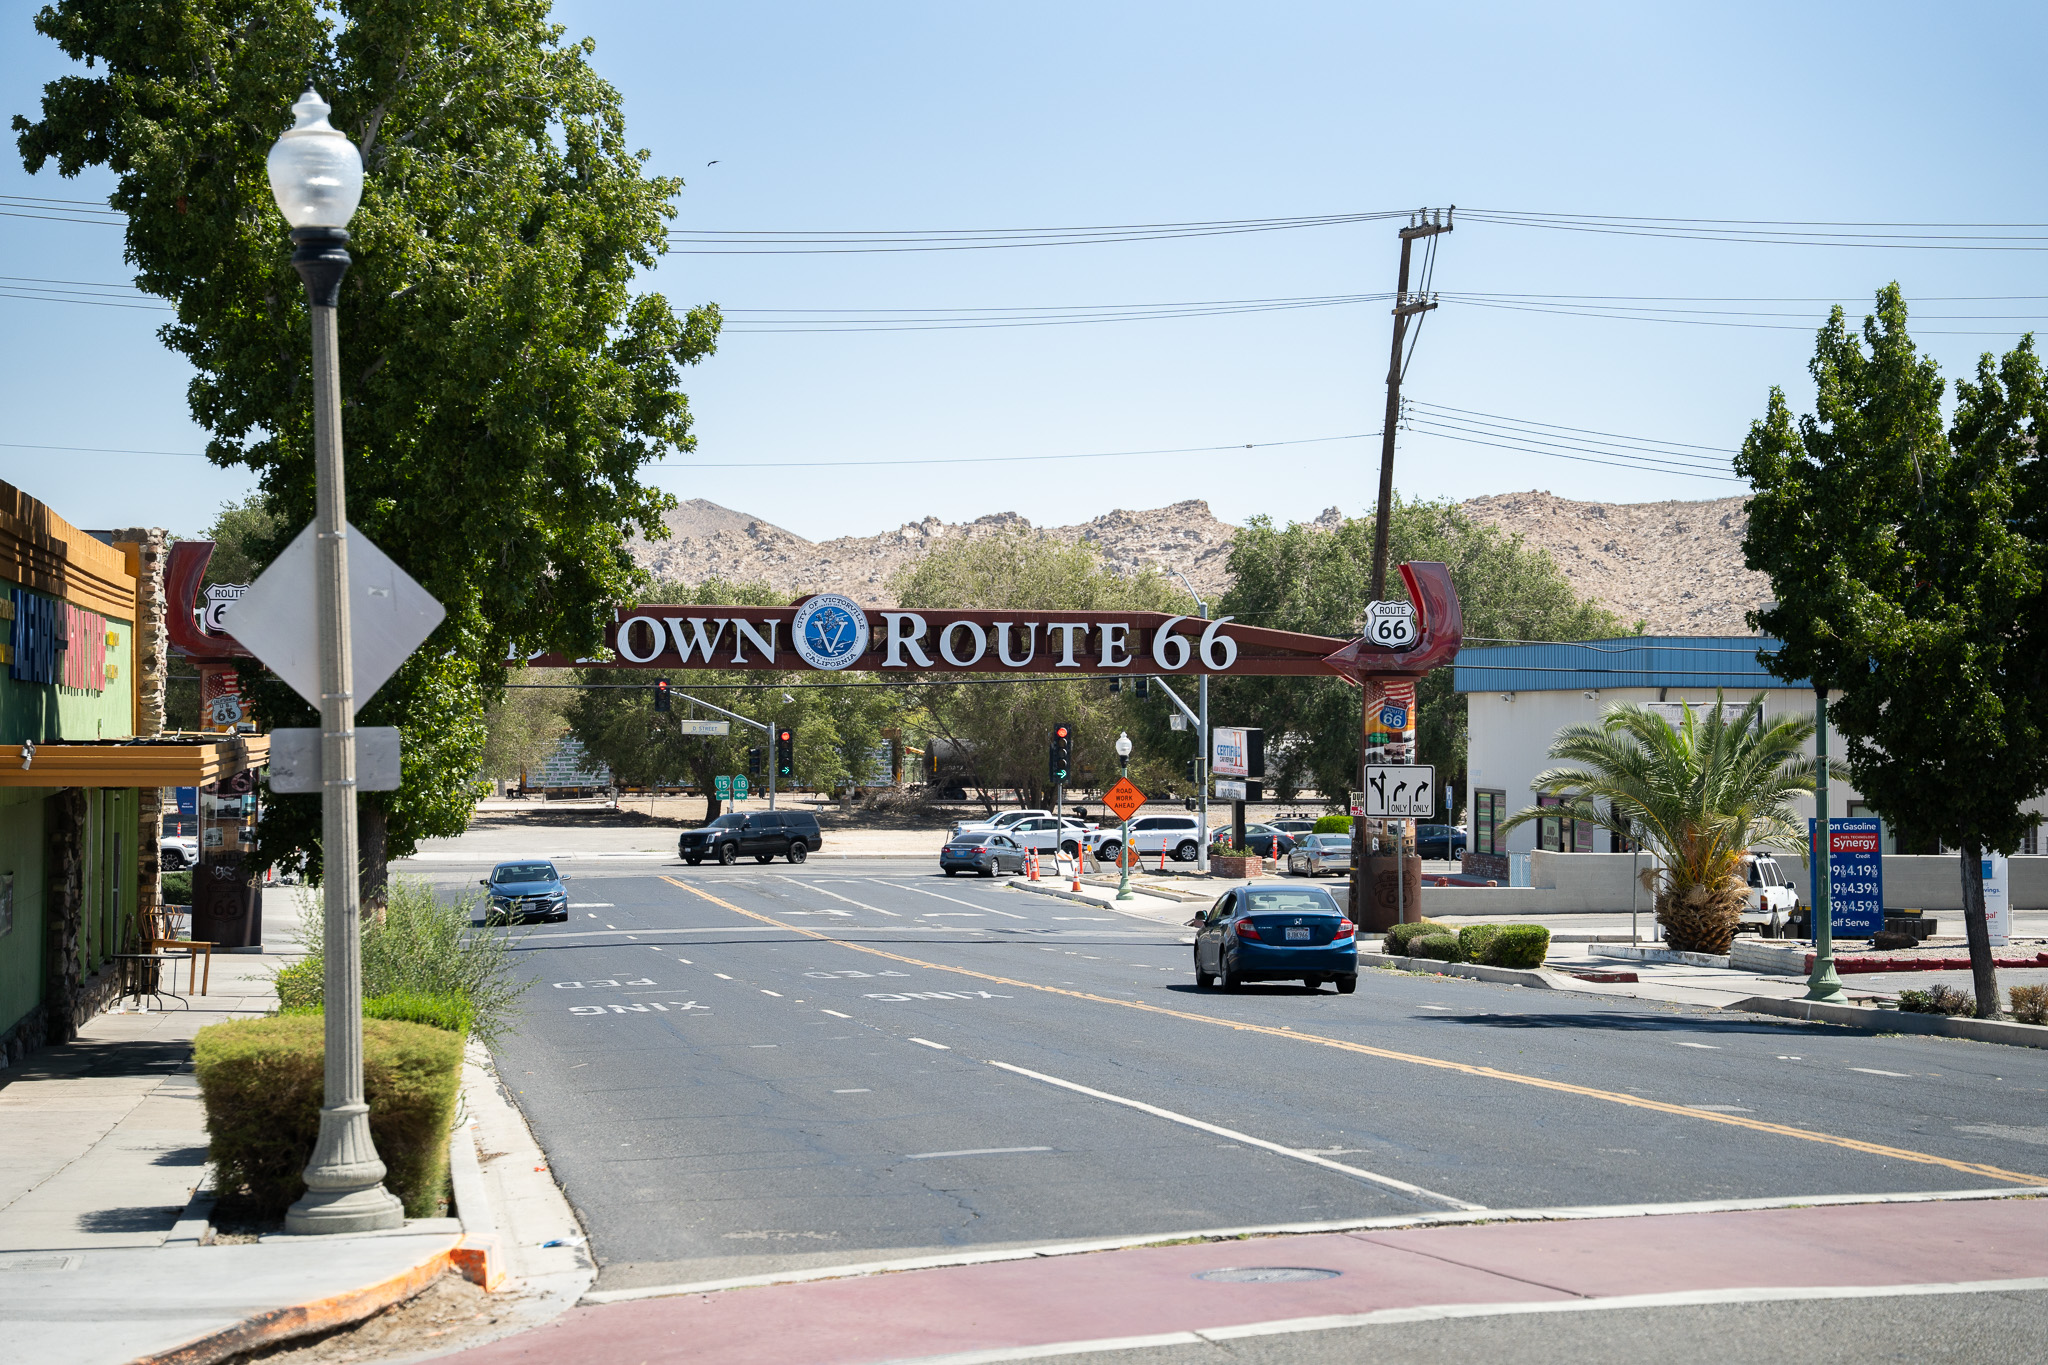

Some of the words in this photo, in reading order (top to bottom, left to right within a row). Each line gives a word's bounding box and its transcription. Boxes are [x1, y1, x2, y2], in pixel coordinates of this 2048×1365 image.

[213, 603, 227, 625] 6
[797, 610, 807, 629] CITY
[808, 600, 819, 609] OF
[822, 597, 866, 630] VICTORVILLE
[1379, 606, 1406, 615] ROUTE
[1378, 619, 1407, 640] 66
[577, 608, 782, 664] OWN
[880, 612, 1132, 667] ROUTE
[1152, 615, 1238, 671] 66
[814, 621, 848, 653] V
[805, 652, 857, 667] CALIFORNIA
[1384, 707, 1404, 716] ROUTE
[1383, 712, 1403, 728] 66
[1216, 744, 1241, 758] CERTIFIED
[718, 780, 728, 789] 15
[737, 780, 746, 788] 18
[1391, 803, 1407, 813] ONLY
[1412, 803, 1430, 813] ONLY
[1842, 822, 1877, 831] Gasoline
[1833, 837, 1876, 850] Synergy
[1847, 865, 1871, 876] 4.19
[1847, 882, 1872, 894] 4.39
[1983, 887, 2001, 895] vings.
[1849, 900, 1872, 912] 4.59
[1845, 918, 1870, 927] Serve
[552, 978, 658, 989] PED
[568, 1001, 711, 1016] XING
